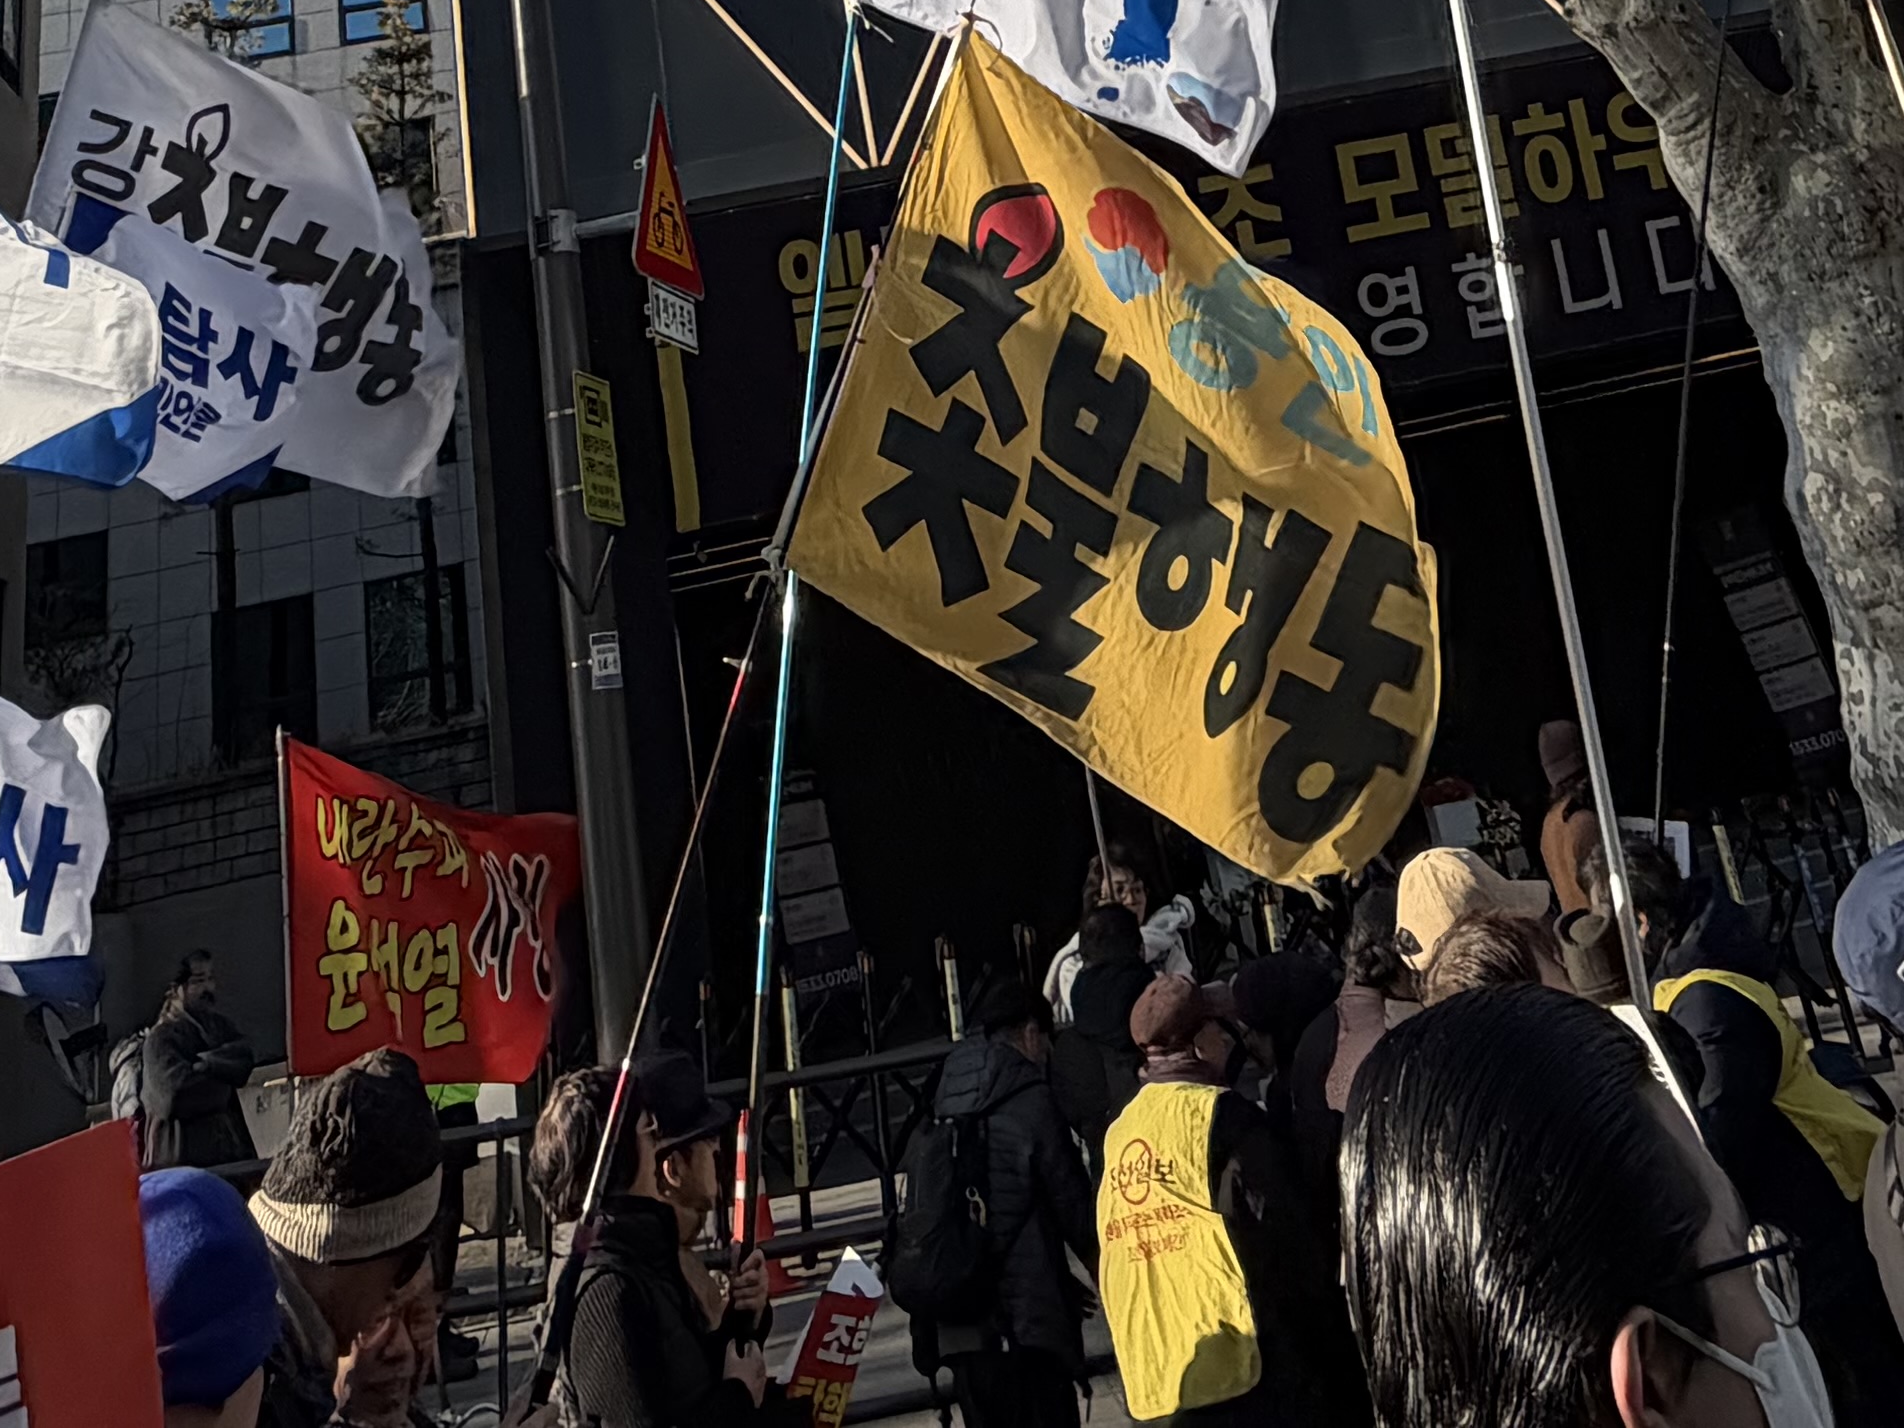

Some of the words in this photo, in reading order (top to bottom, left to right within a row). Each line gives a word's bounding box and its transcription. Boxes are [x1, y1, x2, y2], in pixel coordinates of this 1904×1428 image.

[1337, 89, 1672, 246] 모델하우
[160, 281, 298, 423] 탐사
[862, 228, 1428, 845] 촛불행동
[1789, 728, 1846, 756] 1533.070
[318, 898, 467, 1050] 윤석열
